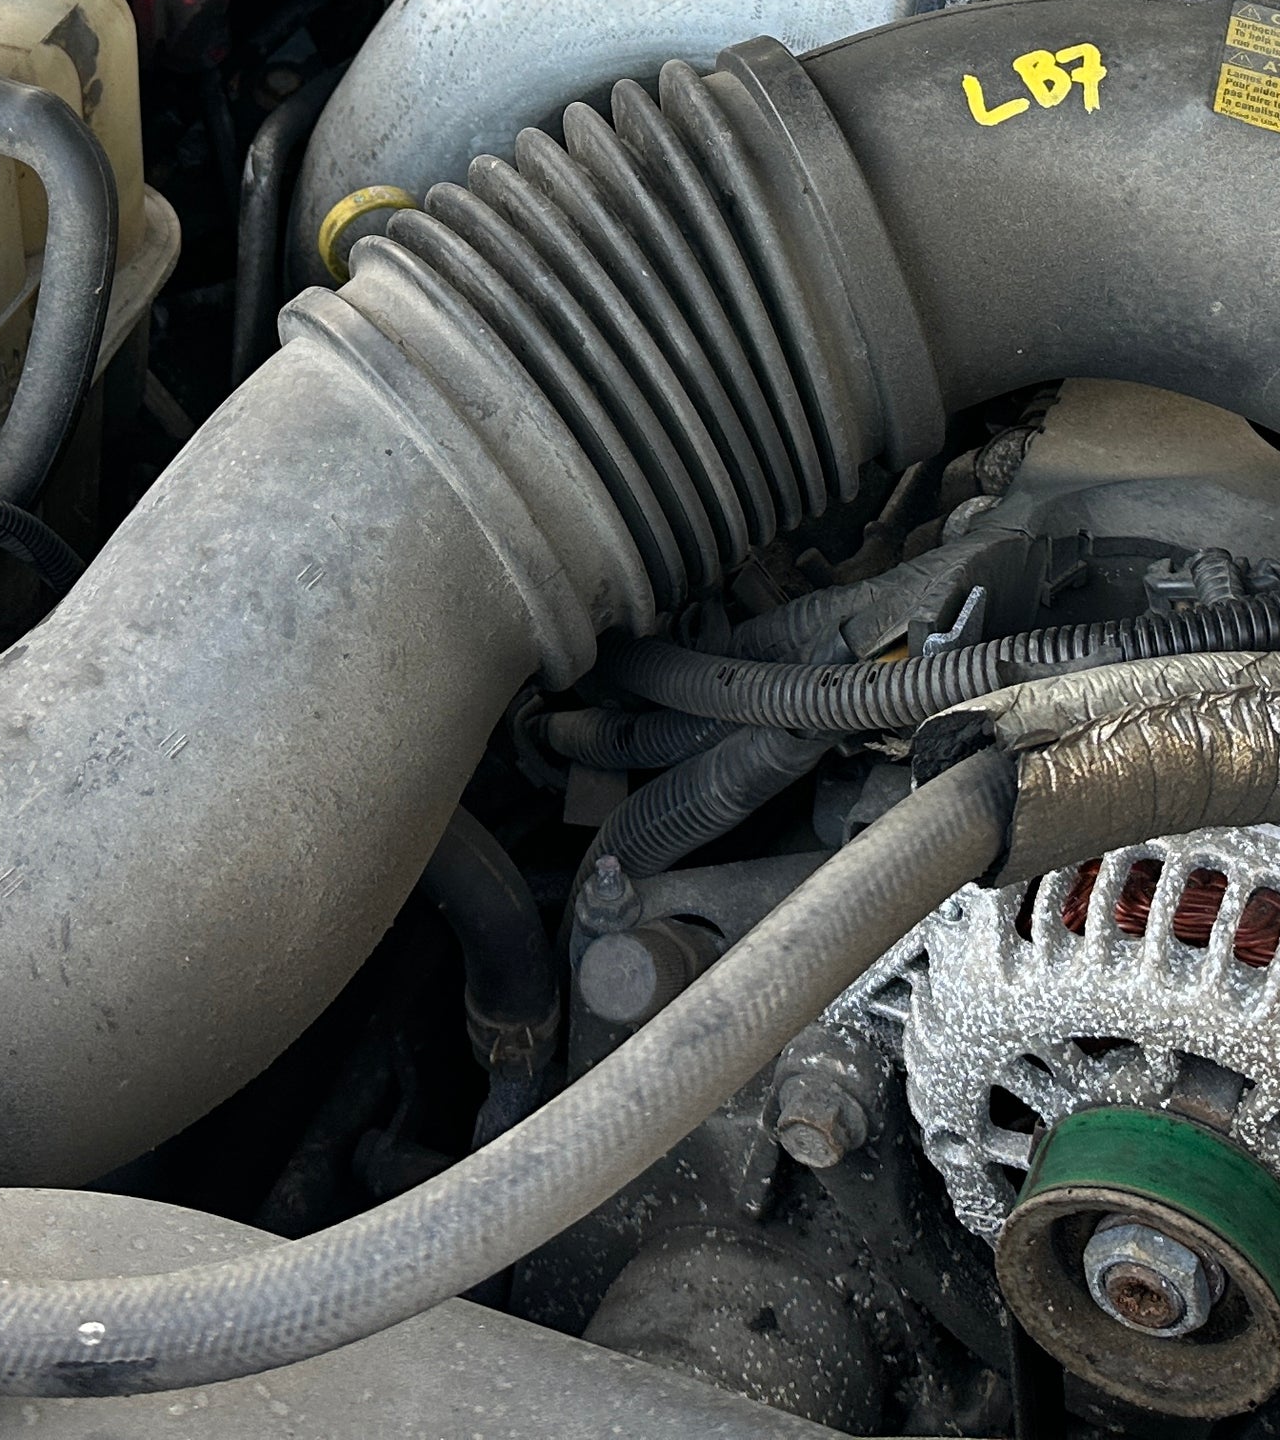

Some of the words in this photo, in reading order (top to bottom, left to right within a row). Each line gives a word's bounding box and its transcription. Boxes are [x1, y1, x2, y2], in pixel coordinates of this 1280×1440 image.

[1248, 31, 1271, 46] help
[961, 41, 1108, 127] LB7
[1227, 68, 1262, 85] Lames
[1223, 88, 1243, 100] pas
[1246, 91, 1271, 106] faire
[1225, 78, 1250, 92] Pour
[1253, 86, 1280, 99] aider
